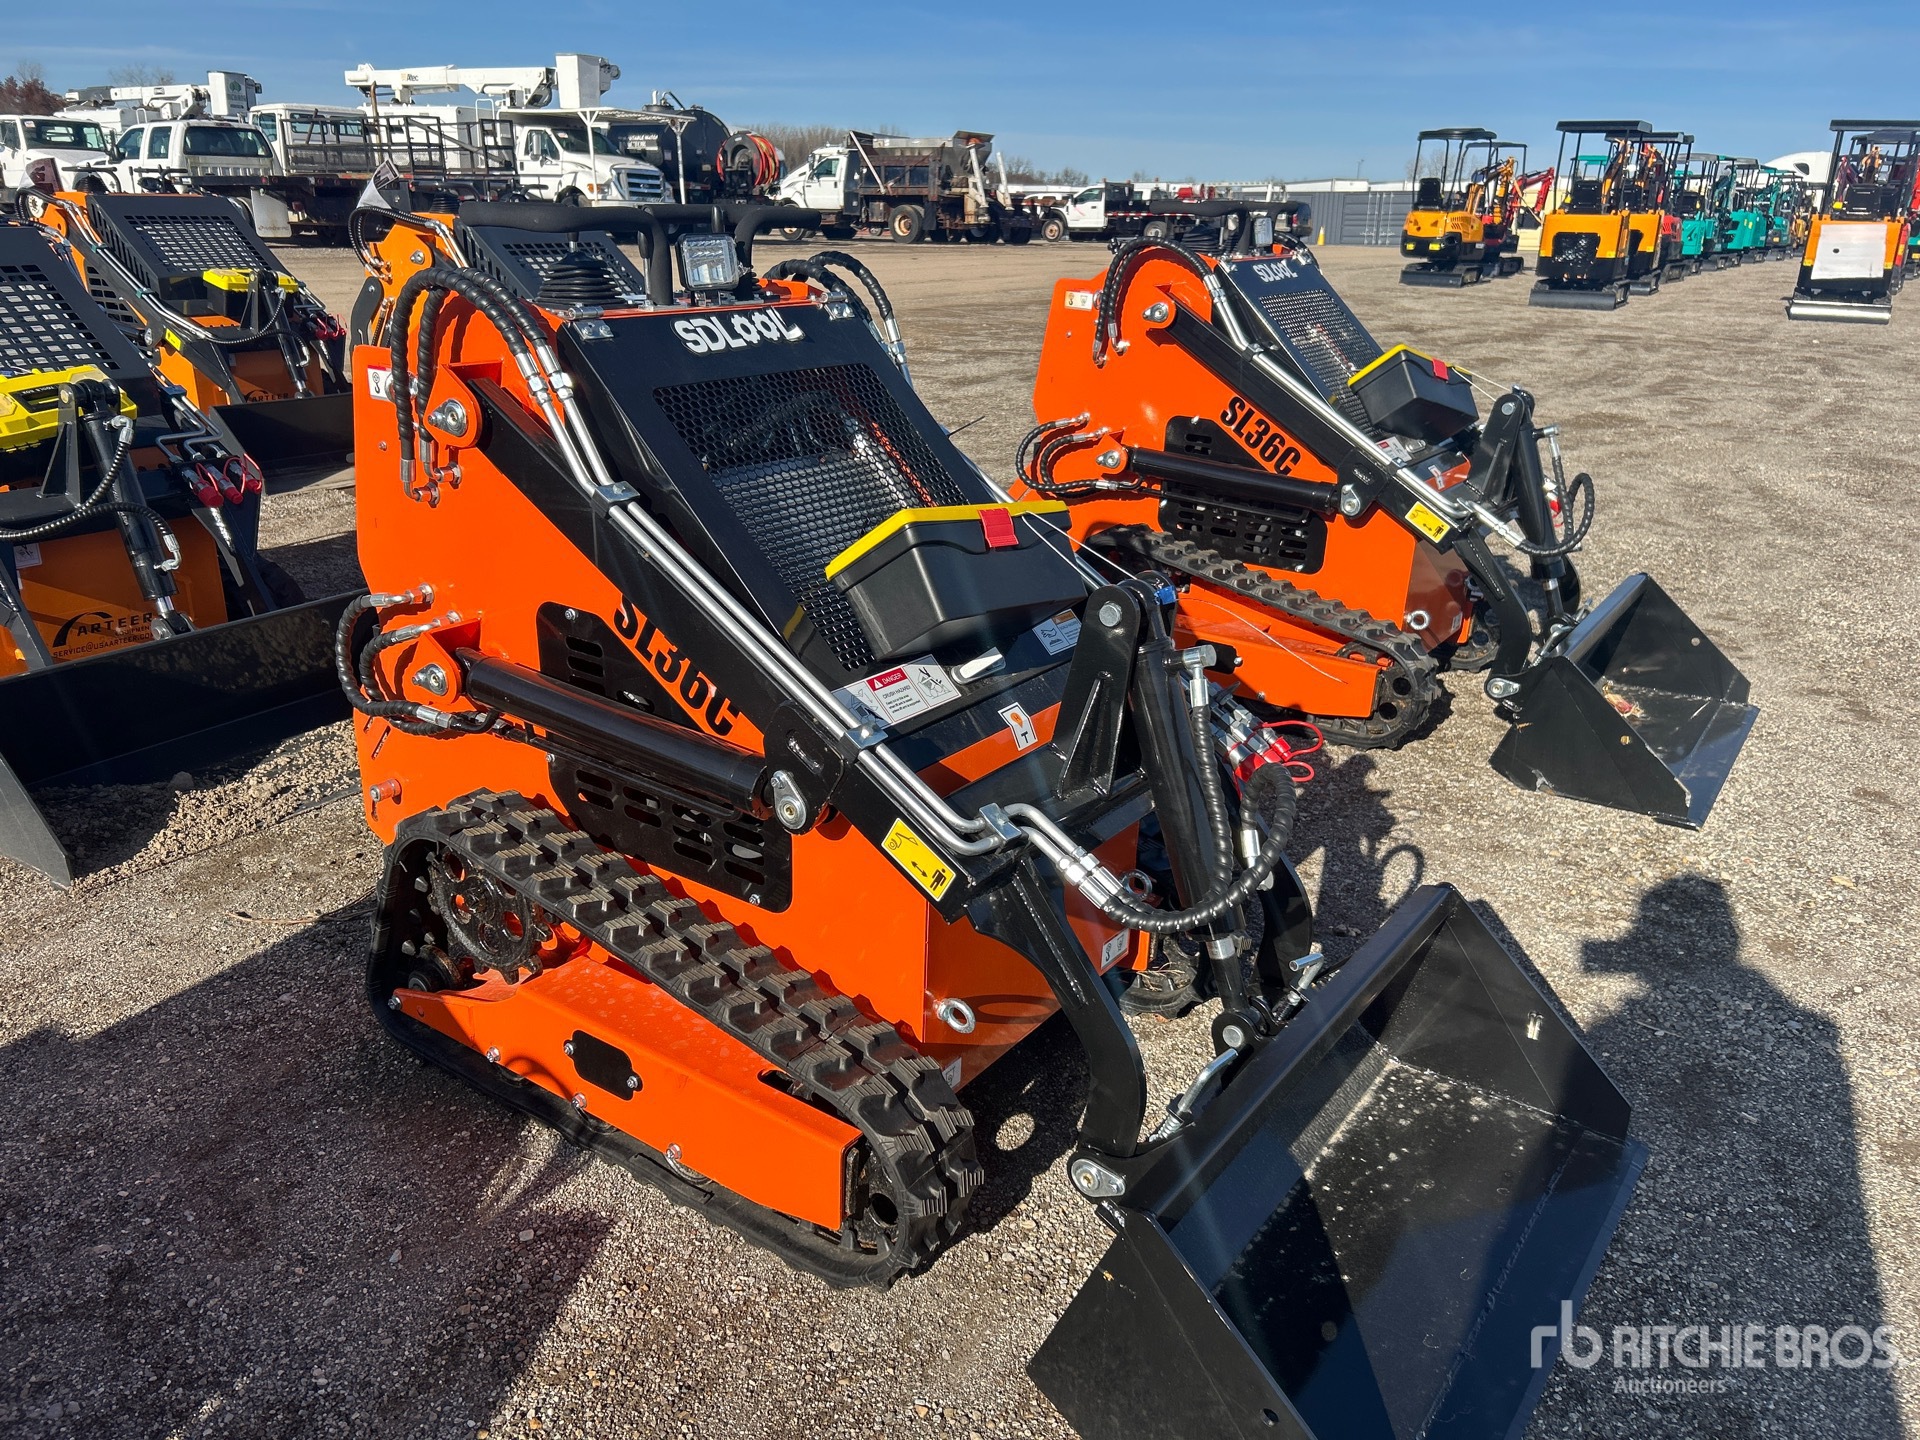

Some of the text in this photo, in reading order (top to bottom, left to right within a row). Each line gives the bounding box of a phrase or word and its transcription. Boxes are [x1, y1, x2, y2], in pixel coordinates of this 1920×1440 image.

[674, 306, 804, 353] SDLOOL
[1220, 396, 1302, 476] SL36C
[77, 612, 153, 637] ARTEER
[613, 594, 739, 736] SL36C
[881, 672, 903, 684] DANGER
